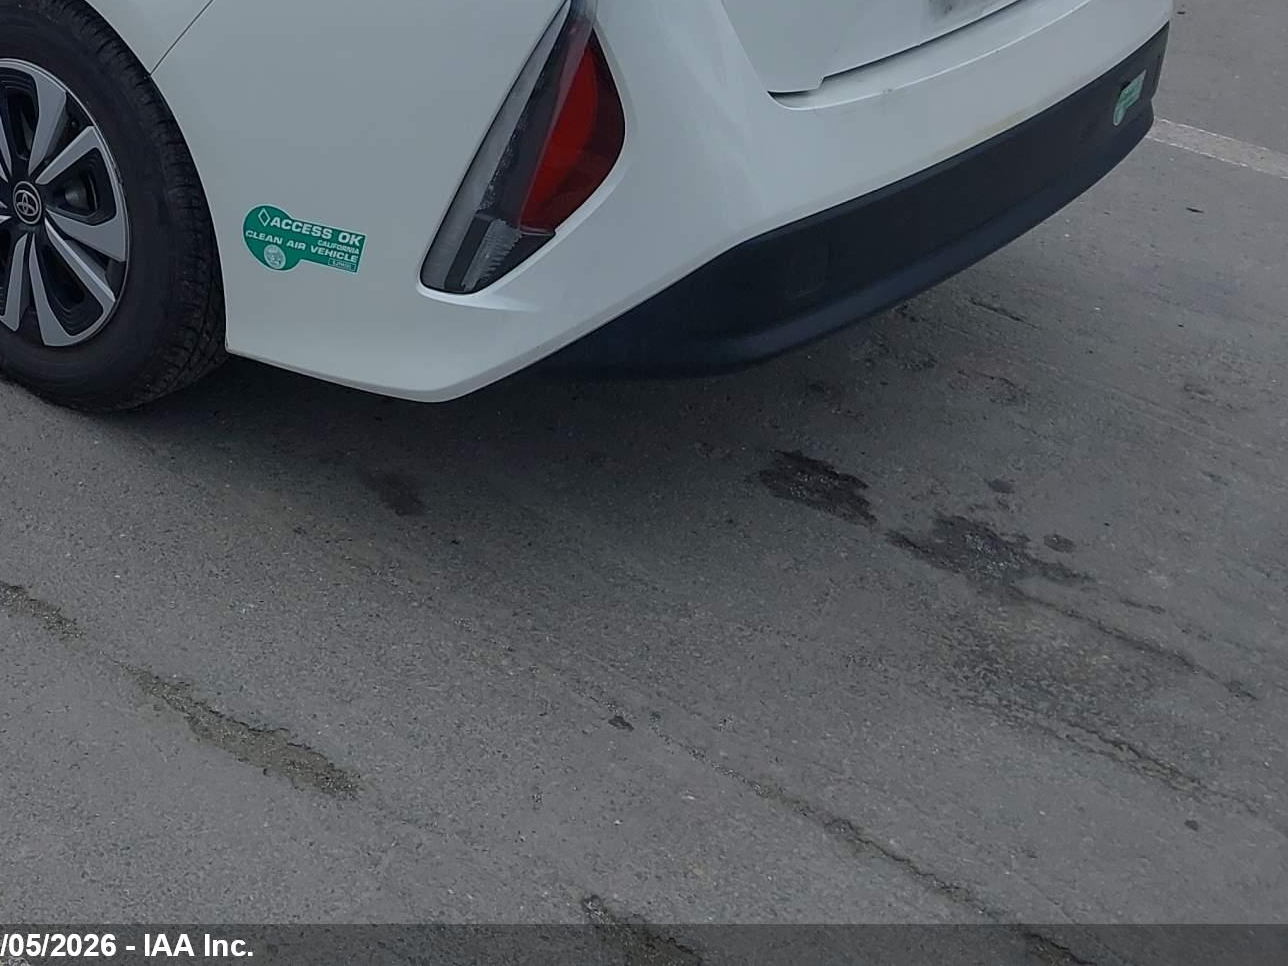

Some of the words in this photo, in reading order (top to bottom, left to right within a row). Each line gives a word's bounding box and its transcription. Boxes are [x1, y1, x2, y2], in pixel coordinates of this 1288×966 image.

[245, 229, 283, 245] CLEAN
[286, 240, 306, 251] AIR
[310, 245, 359, 264] VEHICLE
[269, 216, 333, 240] ACCESS
[338, 231, 364, 247] OK
[317, 239, 360, 255] CALIFORNIA
